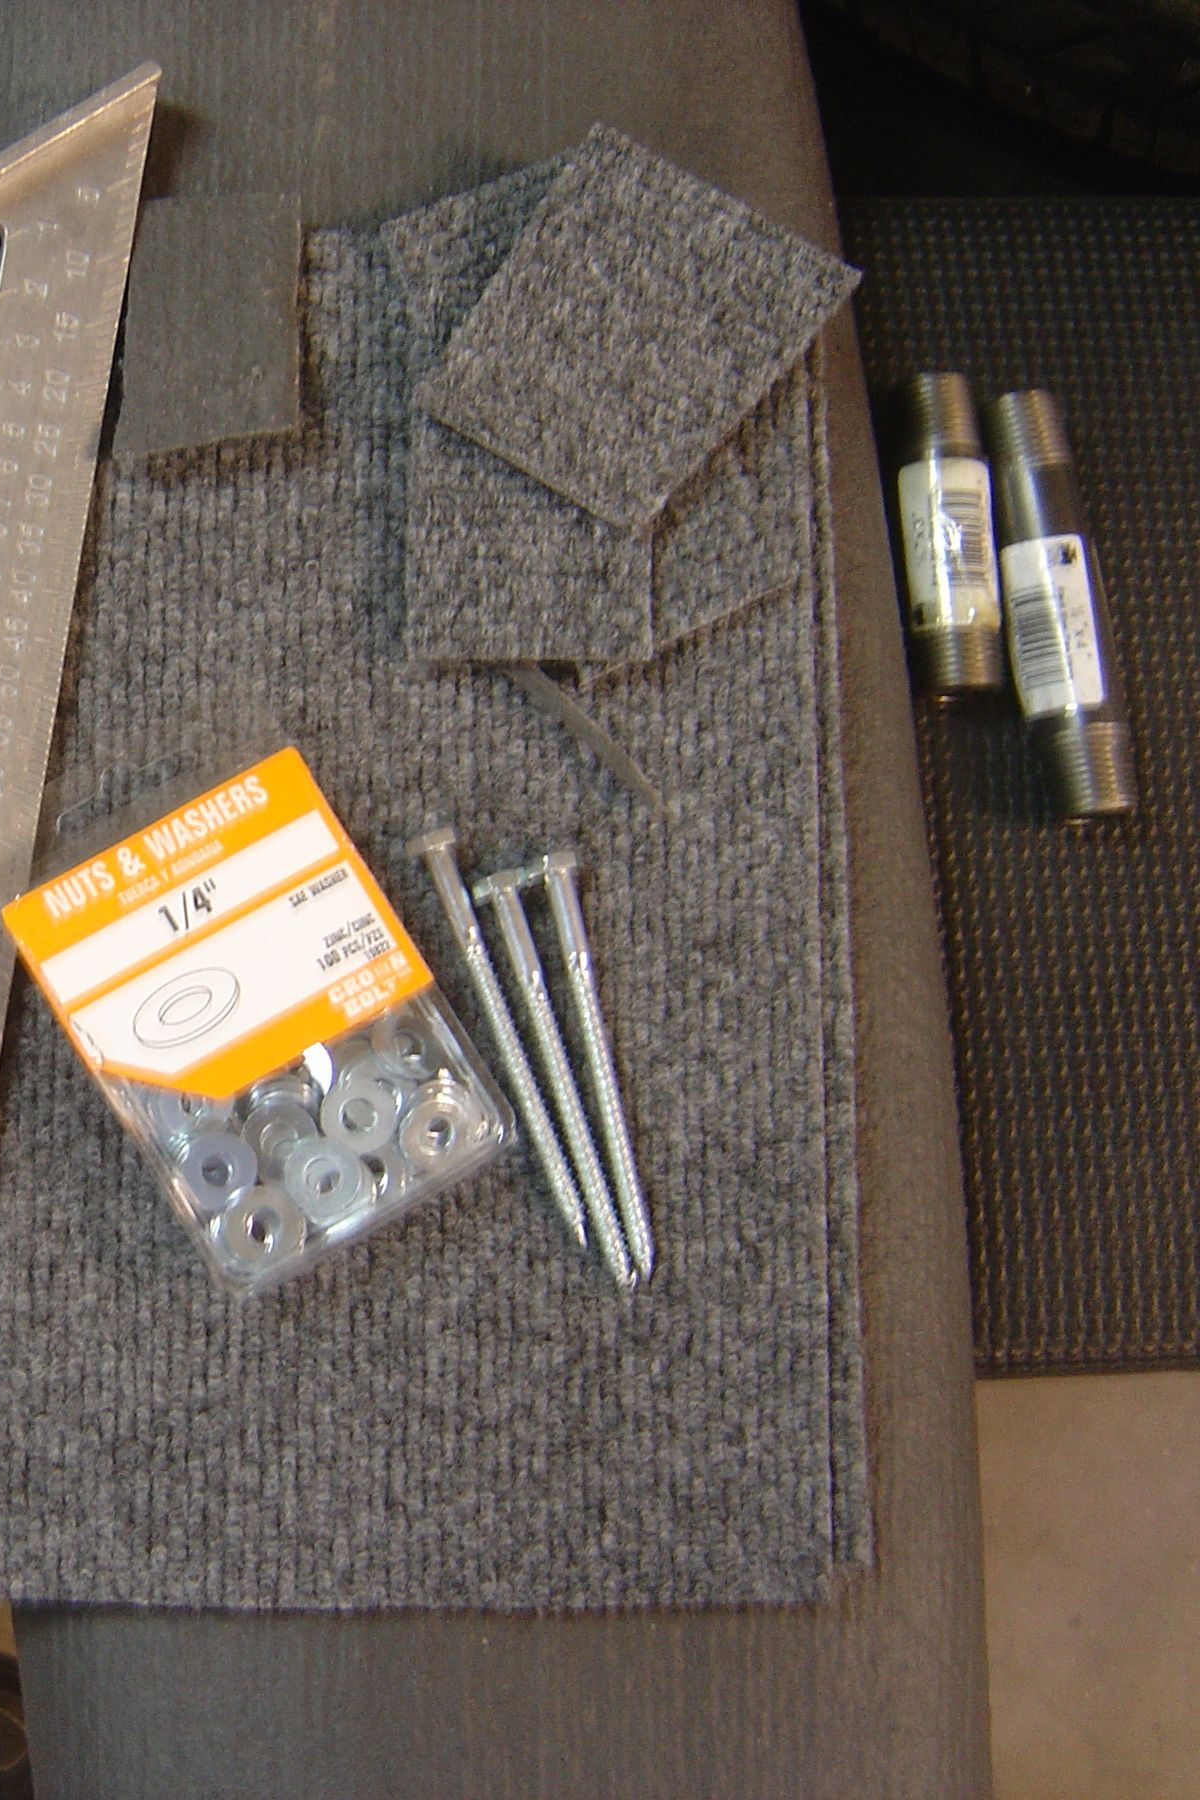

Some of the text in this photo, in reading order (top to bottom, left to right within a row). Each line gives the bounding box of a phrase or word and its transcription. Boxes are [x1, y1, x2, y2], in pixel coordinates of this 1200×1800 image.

[65, 248, 92, 280] 10
[41, 366, 70, 404] 20
[34, 421, 63, 459] 25
[42, 774, 271, 919] NUTS & WASHERS
[311, 867, 351, 902] WASHER
[156, 876, 218, 935] 1/4"
[315, 946, 343, 973] 100
